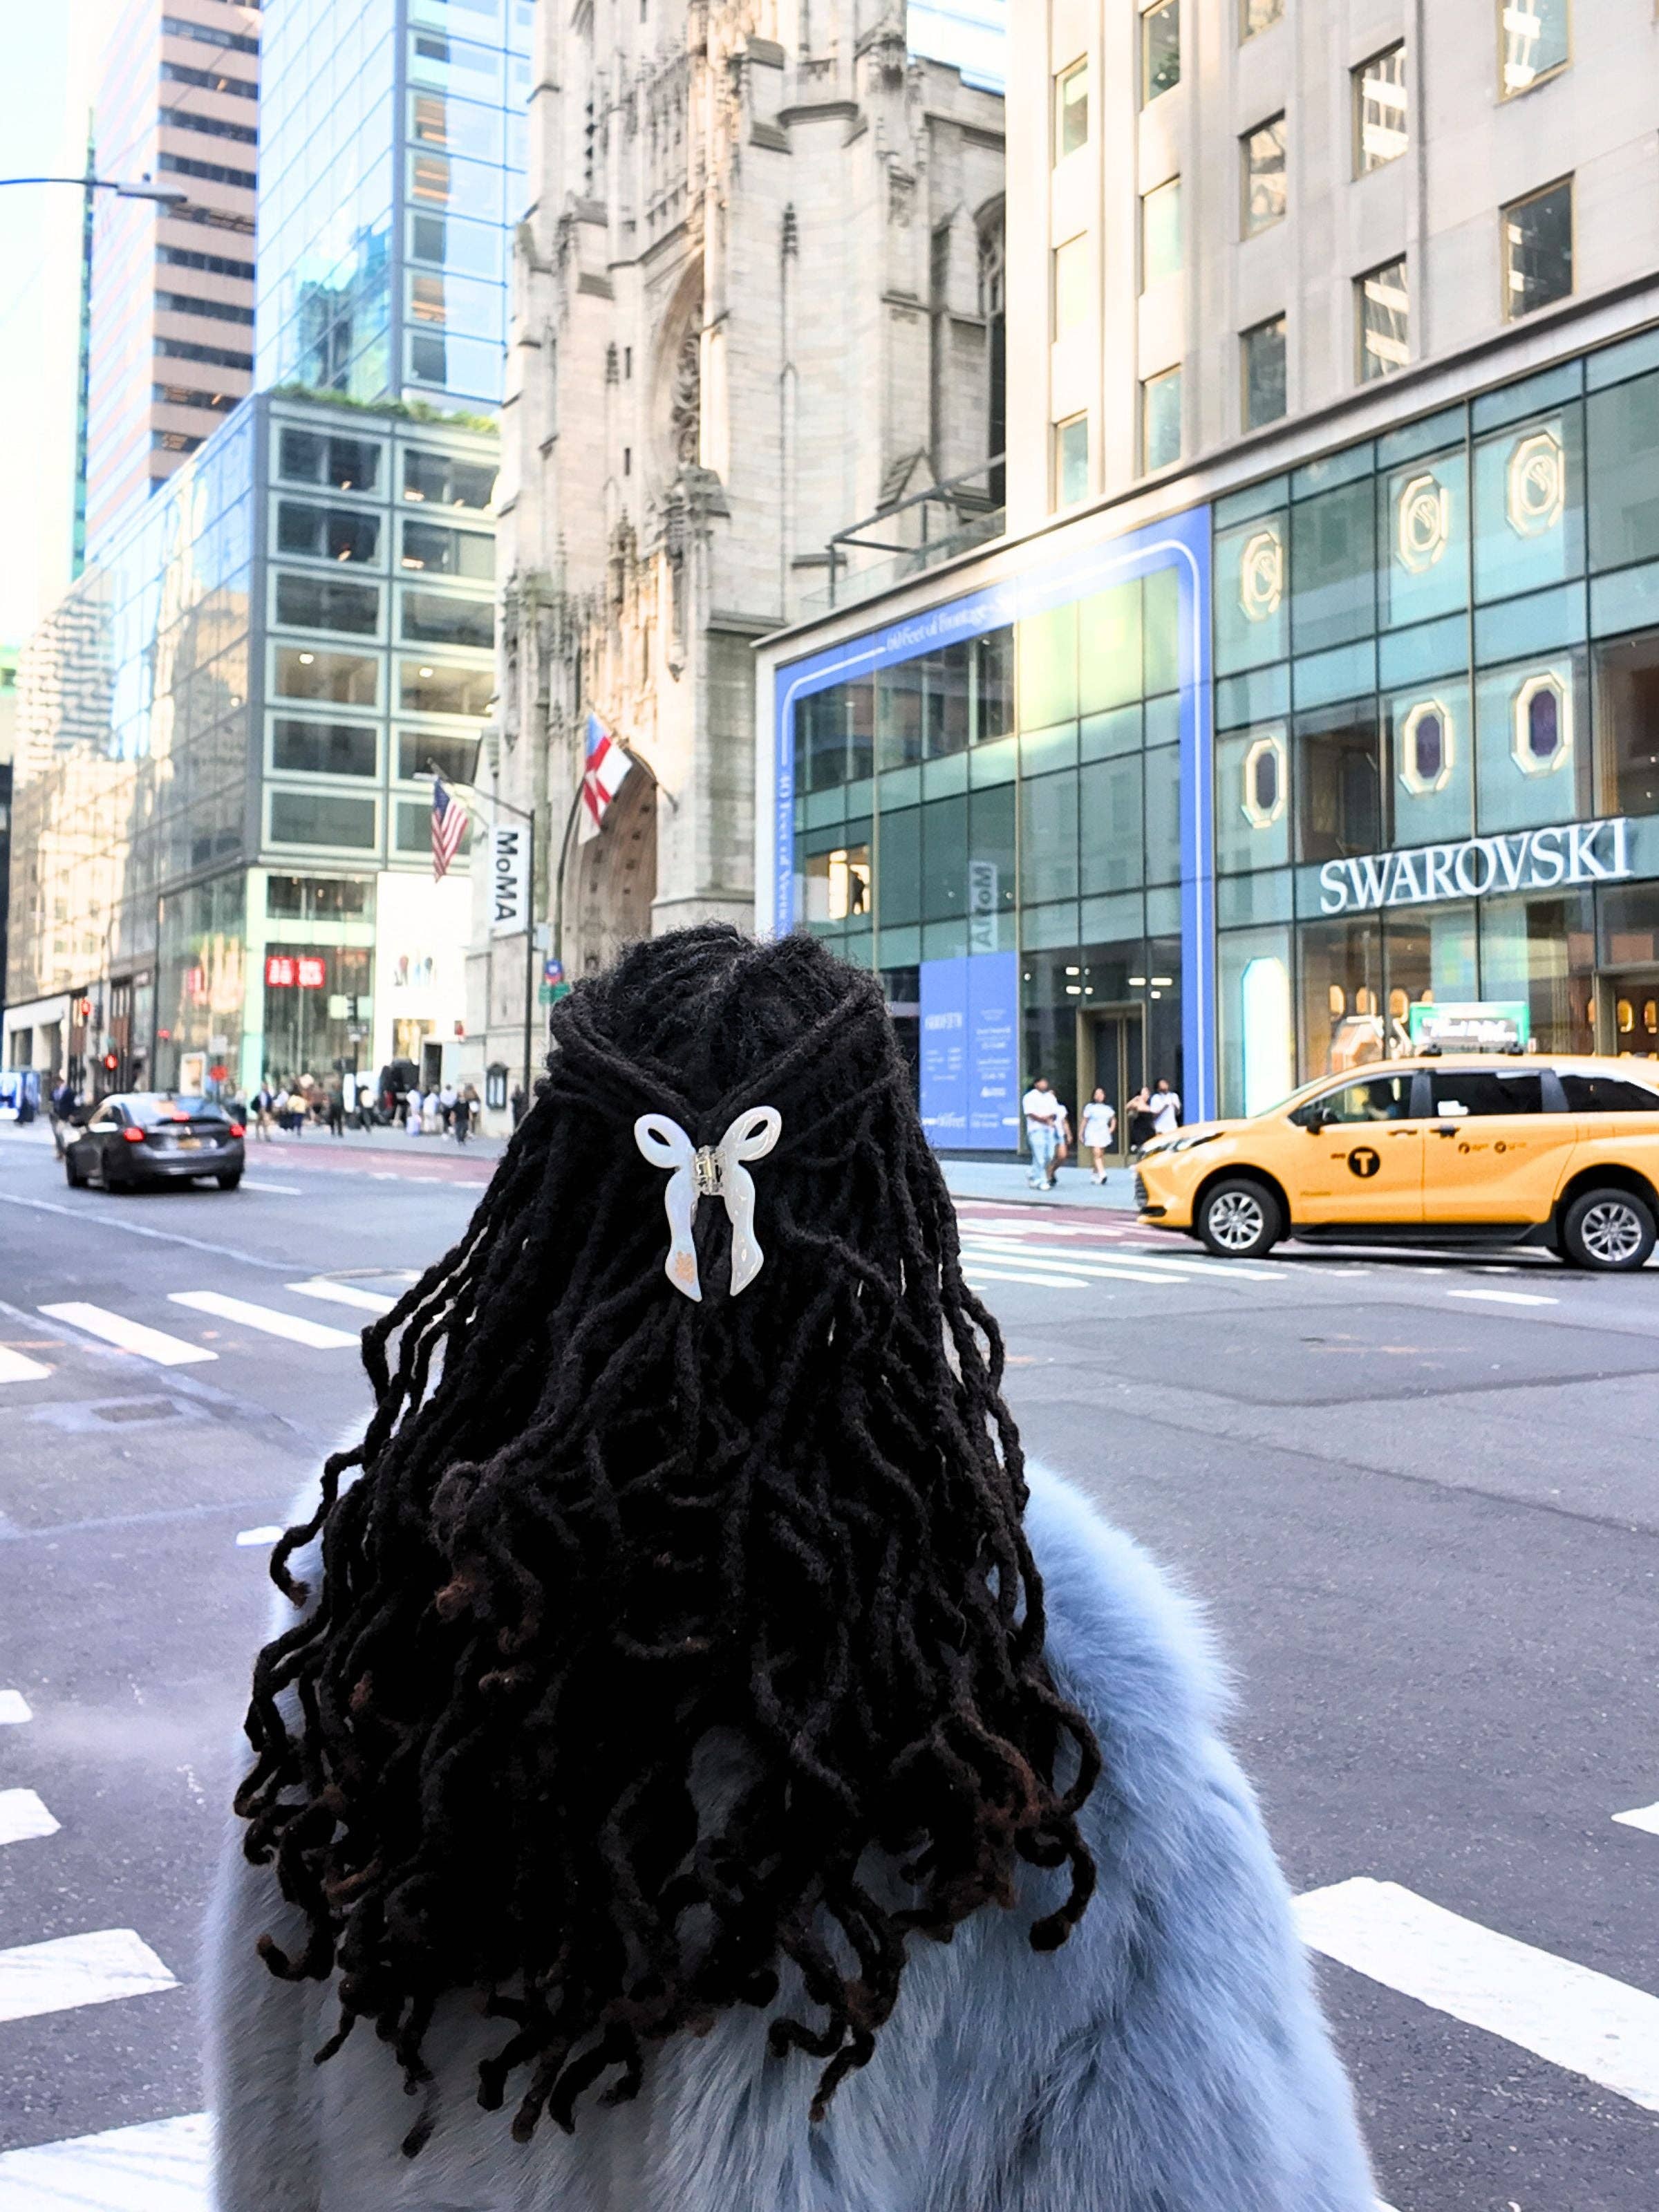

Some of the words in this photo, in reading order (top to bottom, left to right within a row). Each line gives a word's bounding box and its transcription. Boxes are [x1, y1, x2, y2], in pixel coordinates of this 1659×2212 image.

[494, 831, 518, 921] MoMA
[1320, 817, 1635, 914] SWAROVSKI
[1353, 1152, 1374, 1175] T
